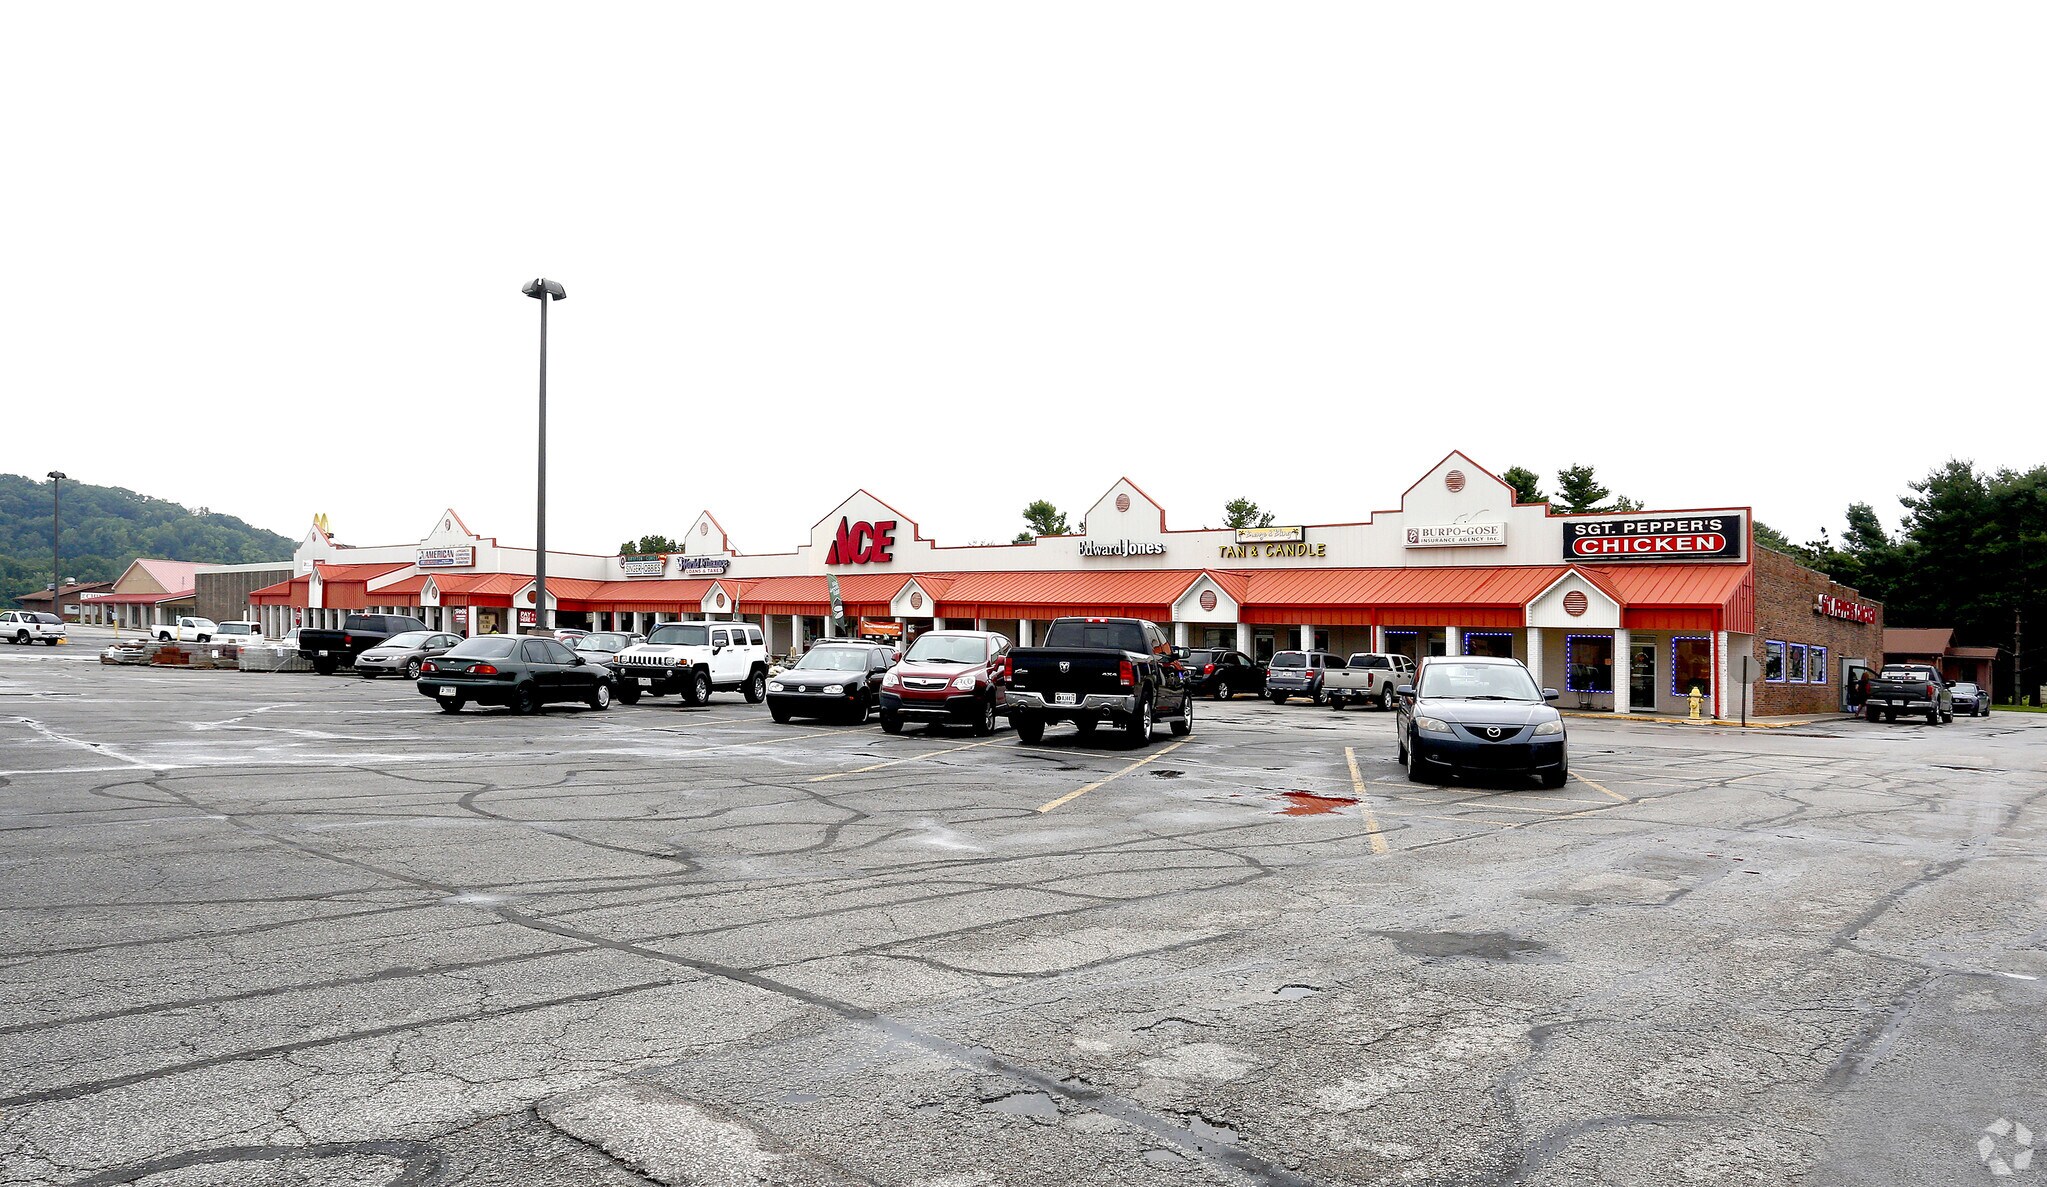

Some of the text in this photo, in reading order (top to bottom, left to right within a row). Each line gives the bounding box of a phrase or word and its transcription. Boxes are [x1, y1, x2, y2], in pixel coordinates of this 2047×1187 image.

[1422, 525, 1499, 537] BURPO-GOSE
[1575, 519, 1723, 536] SGT. PEPPER'S
[825, 516, 897, 565] ACE
[1581, 536, 1715, 554] CHICKEN
[425, 550, 454, 558] AMERICAN
[1218, 543, 1327, 558] TAN & CANDLE
